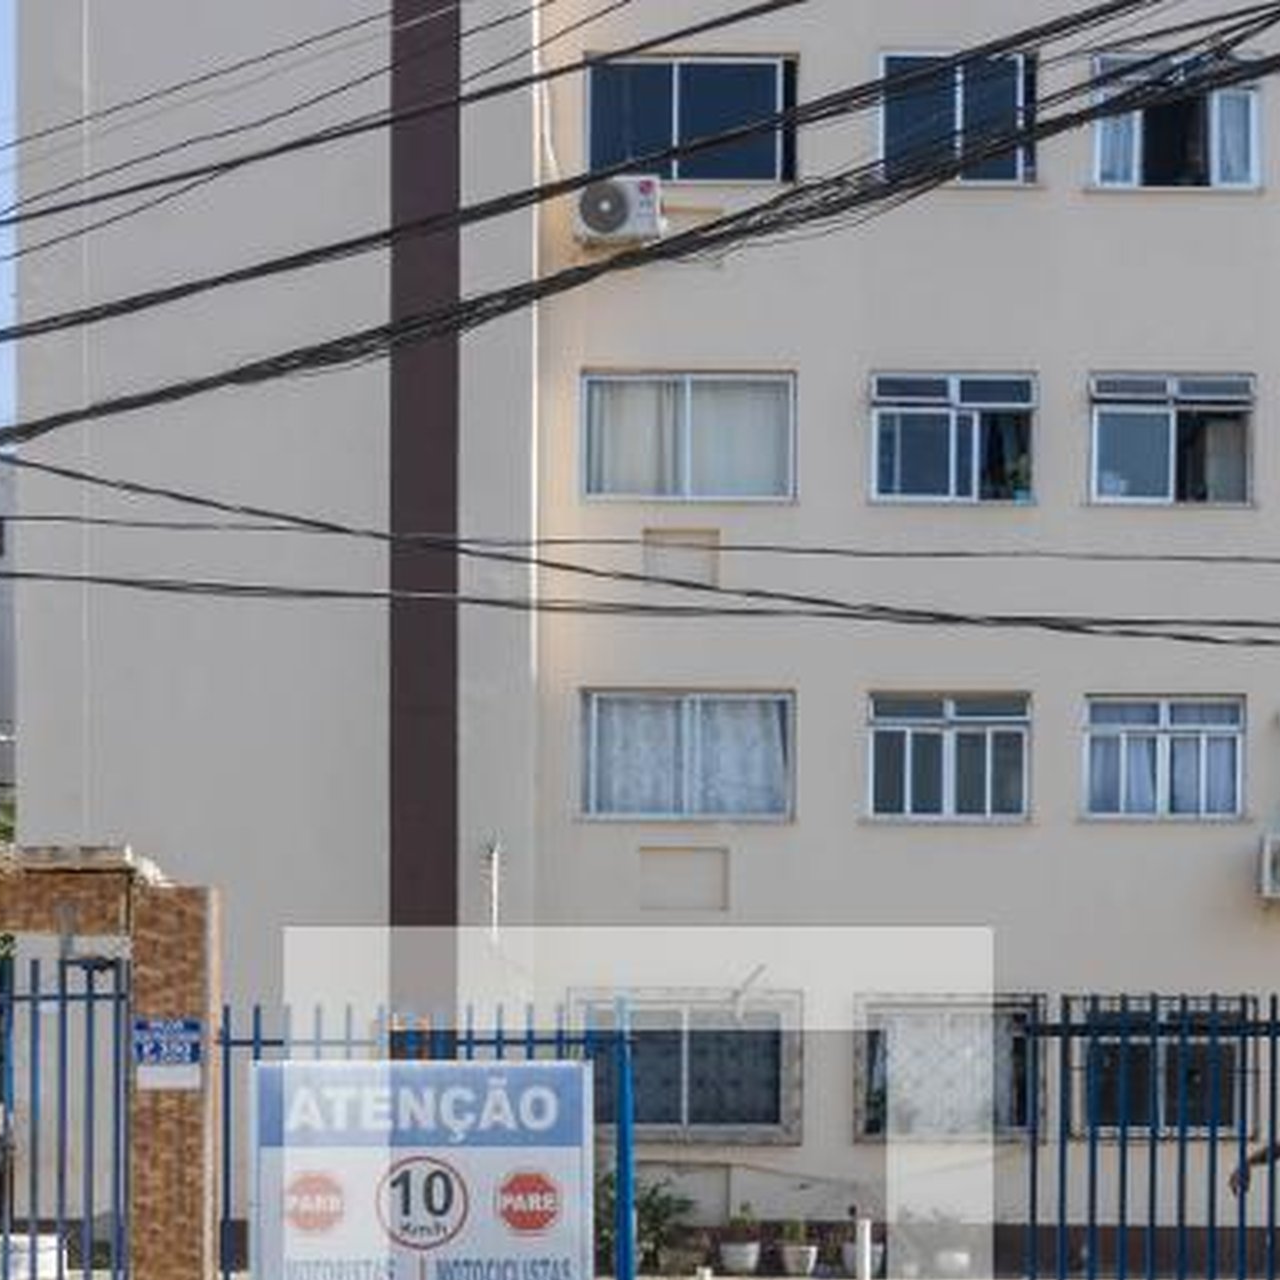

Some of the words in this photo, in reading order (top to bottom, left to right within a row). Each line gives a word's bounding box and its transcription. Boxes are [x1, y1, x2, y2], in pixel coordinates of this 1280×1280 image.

[285, 1074, 559, 1142] ATENÇÃO
[390, 1169, 454, 1217] 10
[497, 1192, 558, 1213] PARE
